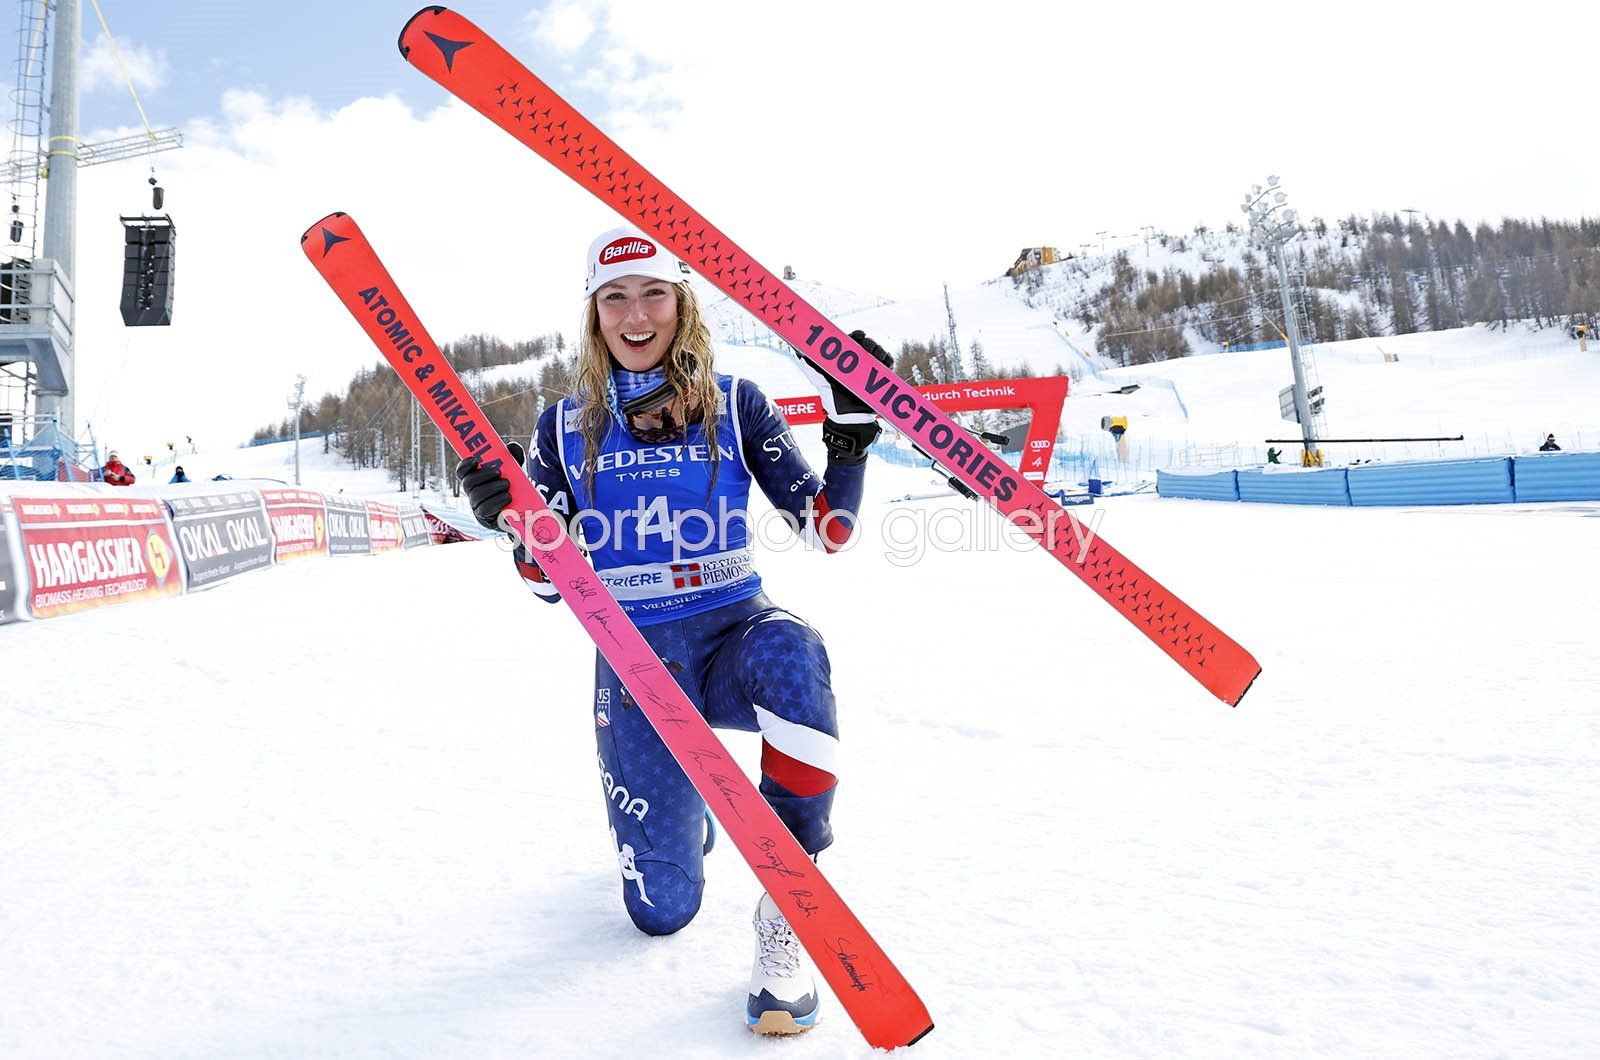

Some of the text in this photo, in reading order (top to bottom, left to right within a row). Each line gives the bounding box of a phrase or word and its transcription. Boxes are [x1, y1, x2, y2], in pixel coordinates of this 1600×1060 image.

[603, 241, 652, 262] Barilla
[358, 286, 423, 363] ATOMIC
[415, 364, 435, 383] &
[922, 386, 1016, 401] durch Technik
[805, 324, 1018, 502] 100 VICTORIES
[569, 444, 735, 480] VEDESTEN
[615, 468, 681, 482] TYRES
[529, 477, 570, 515] SA
[634, 495, 678, 543] 4
[180, 516, 268, 561] OKAL OKAL
[29, 536, 147, 588] HARGASSNER
[35, 589, 72, 608] BIOMASS
[598, 689, 610, 702] US
